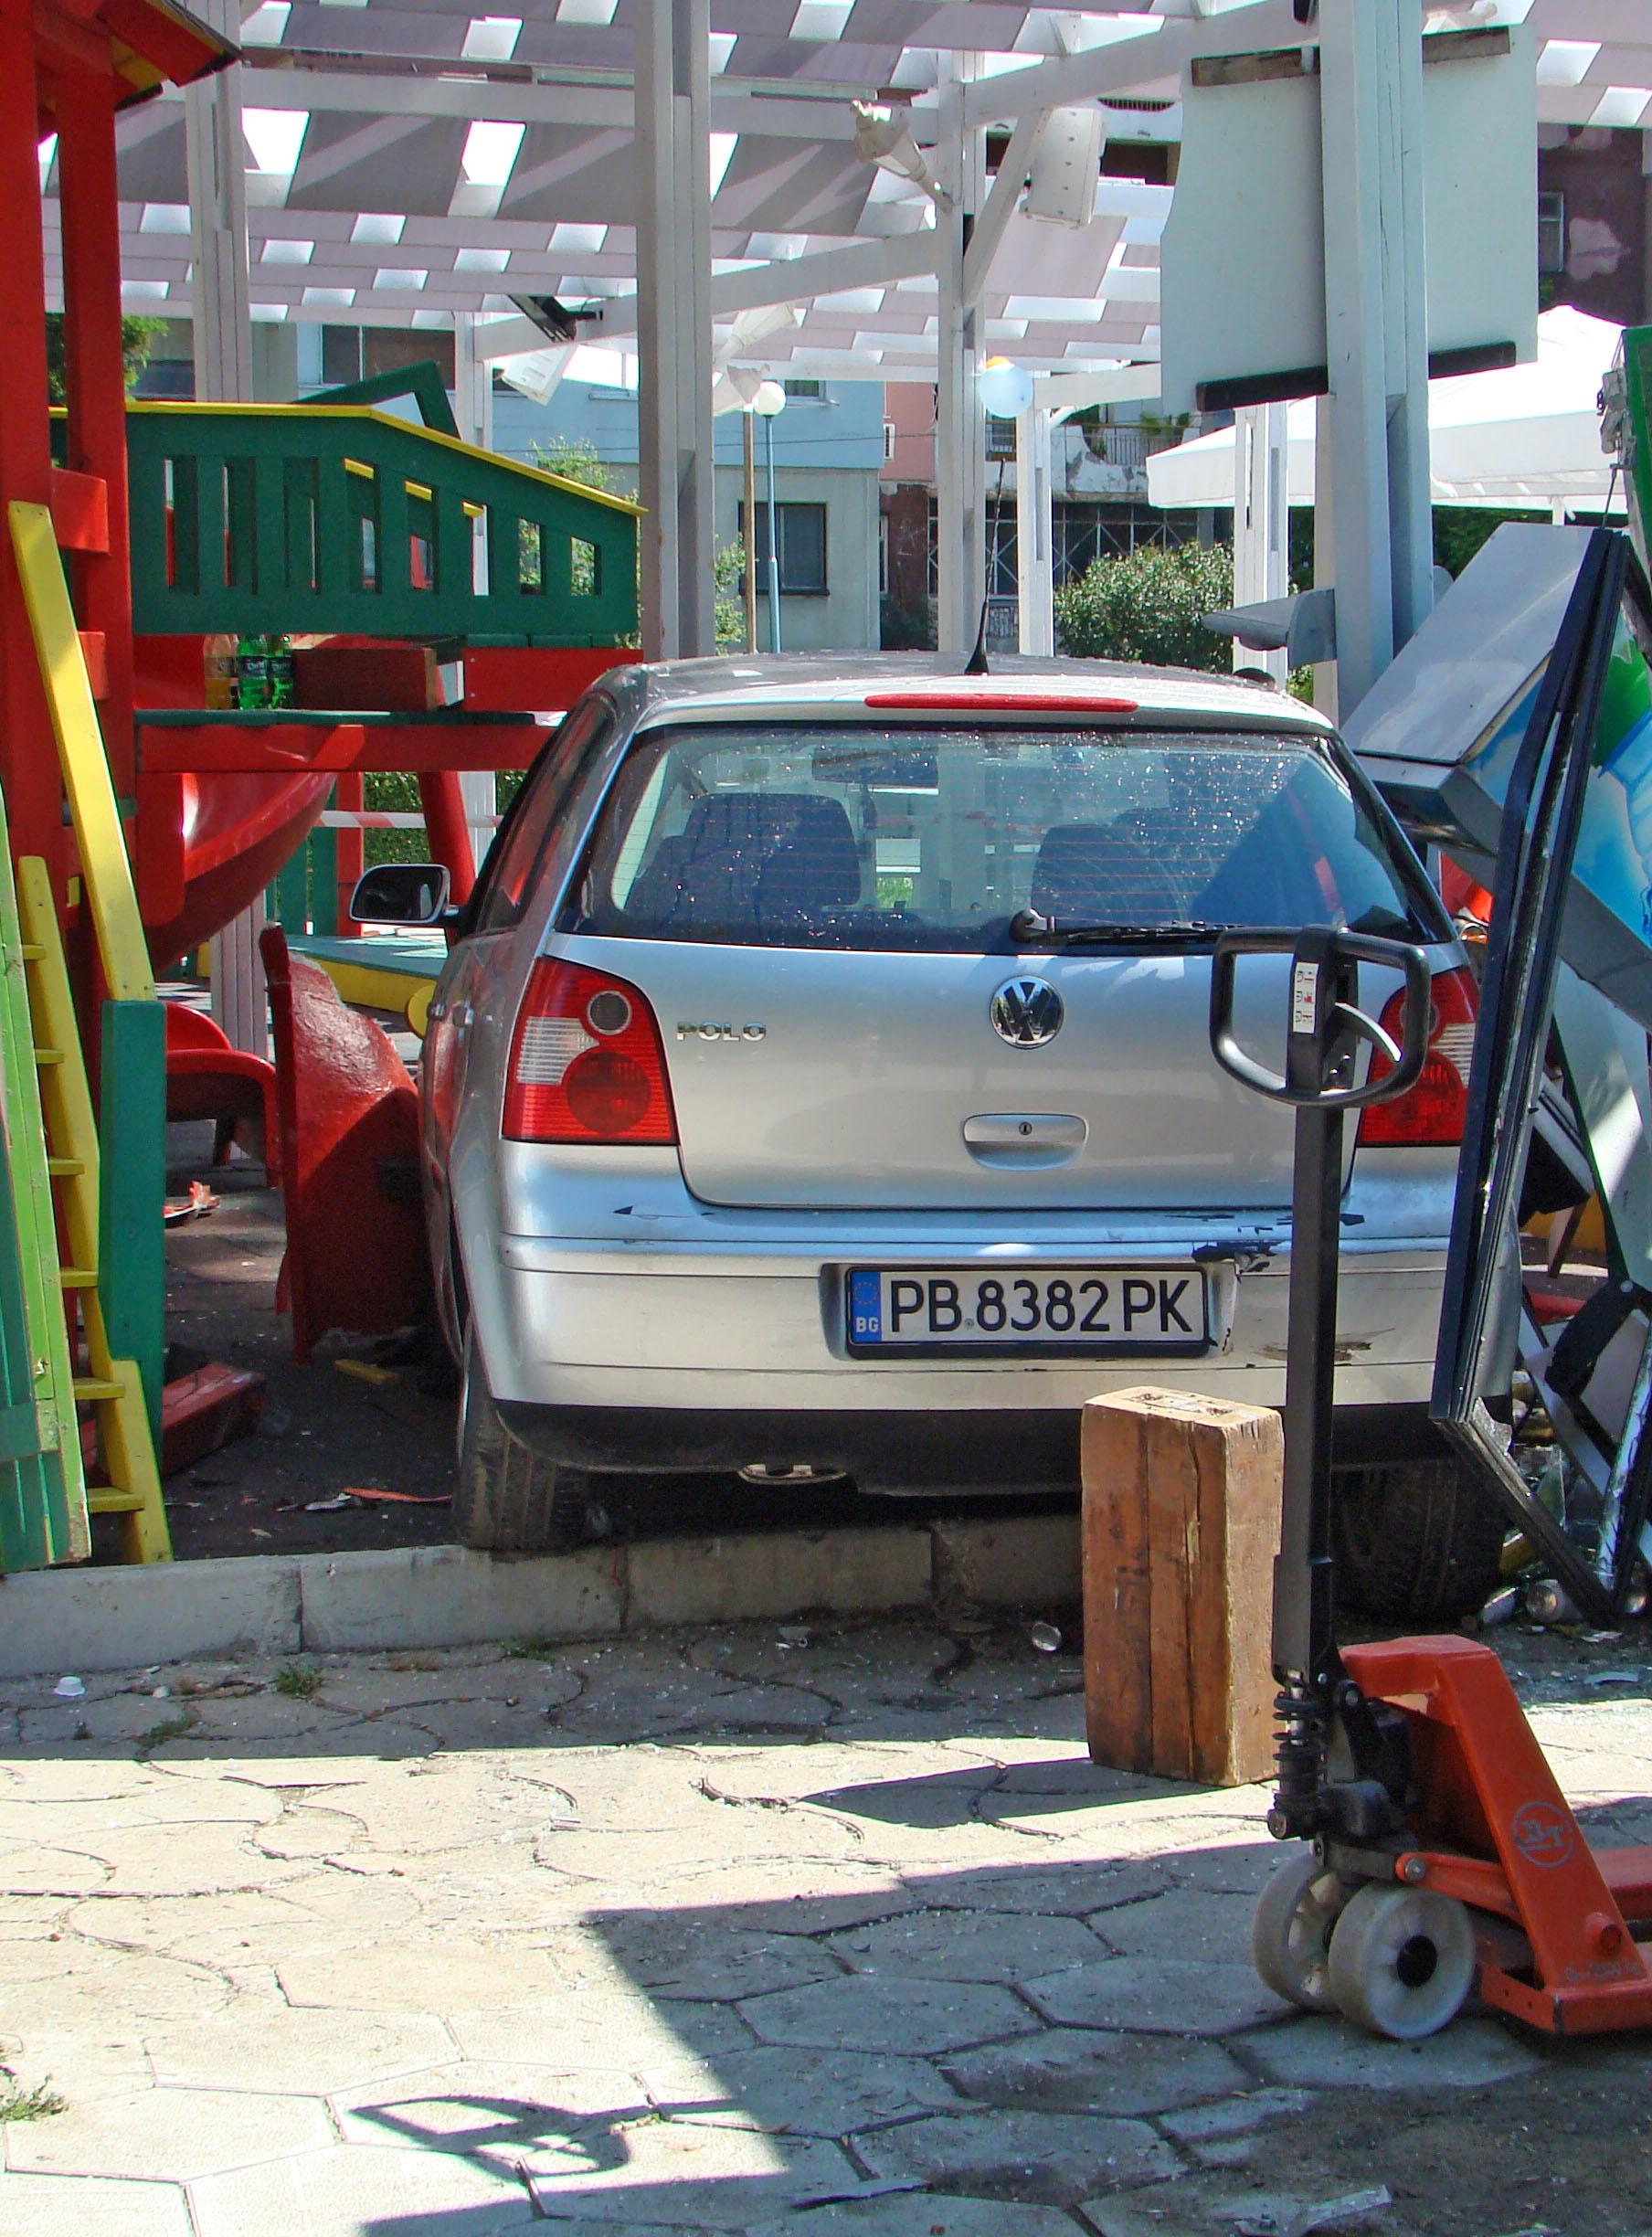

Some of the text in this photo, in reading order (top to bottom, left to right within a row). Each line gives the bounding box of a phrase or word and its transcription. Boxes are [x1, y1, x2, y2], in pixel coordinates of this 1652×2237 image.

[991, 975, 1064, 1049] VW
[676, 1021, 767, 1042] POLO
[856, 1317, 879, 1332] BG
